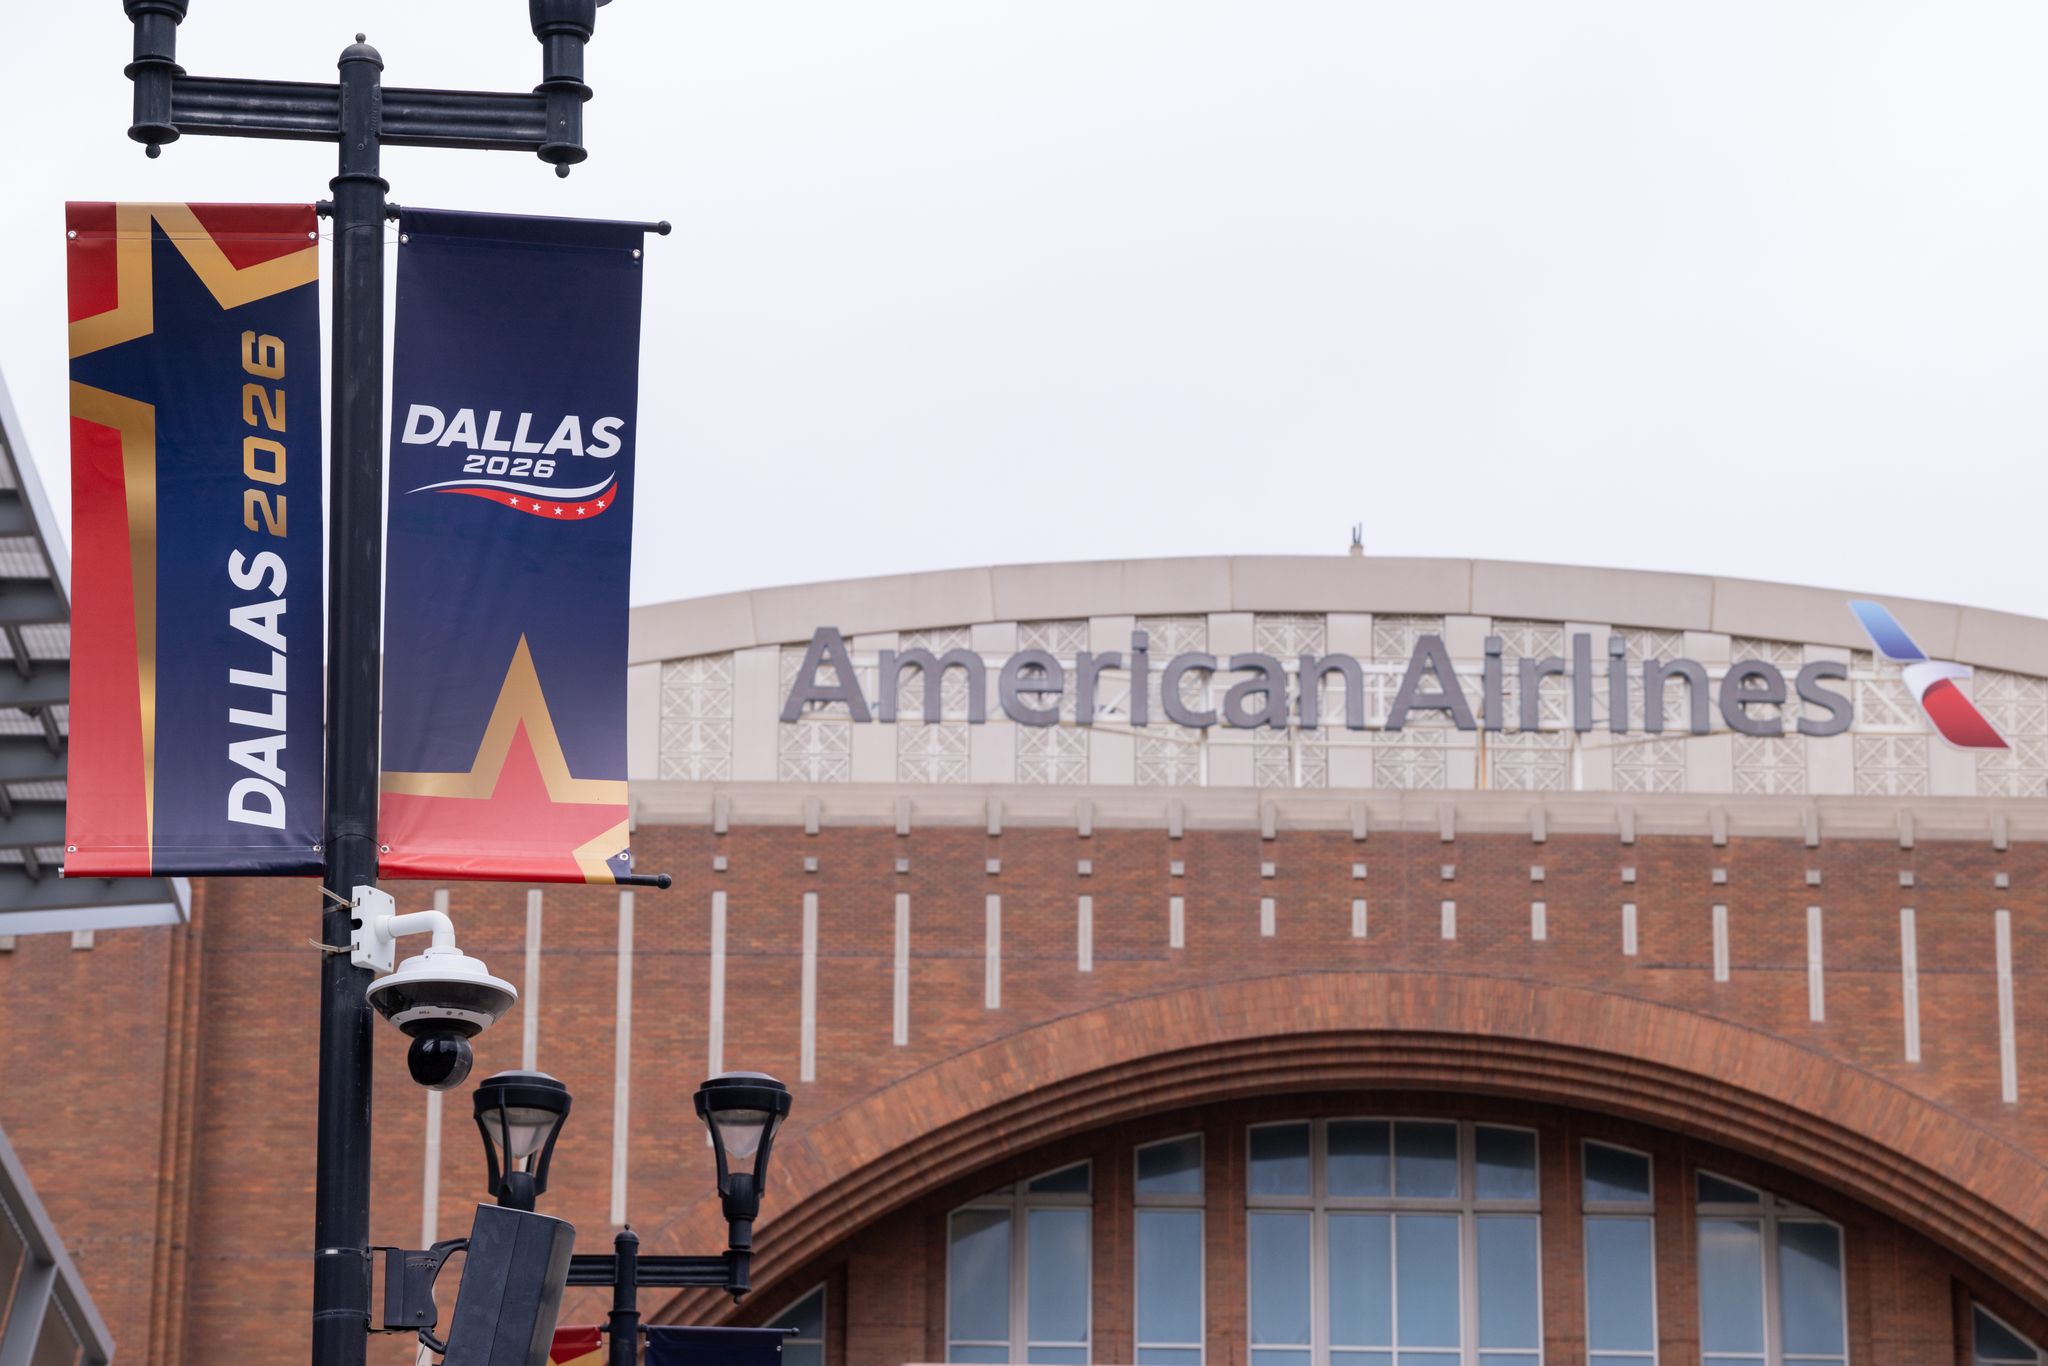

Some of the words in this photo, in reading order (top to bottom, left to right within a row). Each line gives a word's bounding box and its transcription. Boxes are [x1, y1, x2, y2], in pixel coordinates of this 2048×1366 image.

[242, 330, 287, 538] 2026
[401, 403, 625, 459] DALLAS
[463, 453, 556, 478] 2026
[228, 549, 288, 829] DALLAS
[779, 626, 1365, 731] American
[1385, 632, 1854, 738] Airlines
